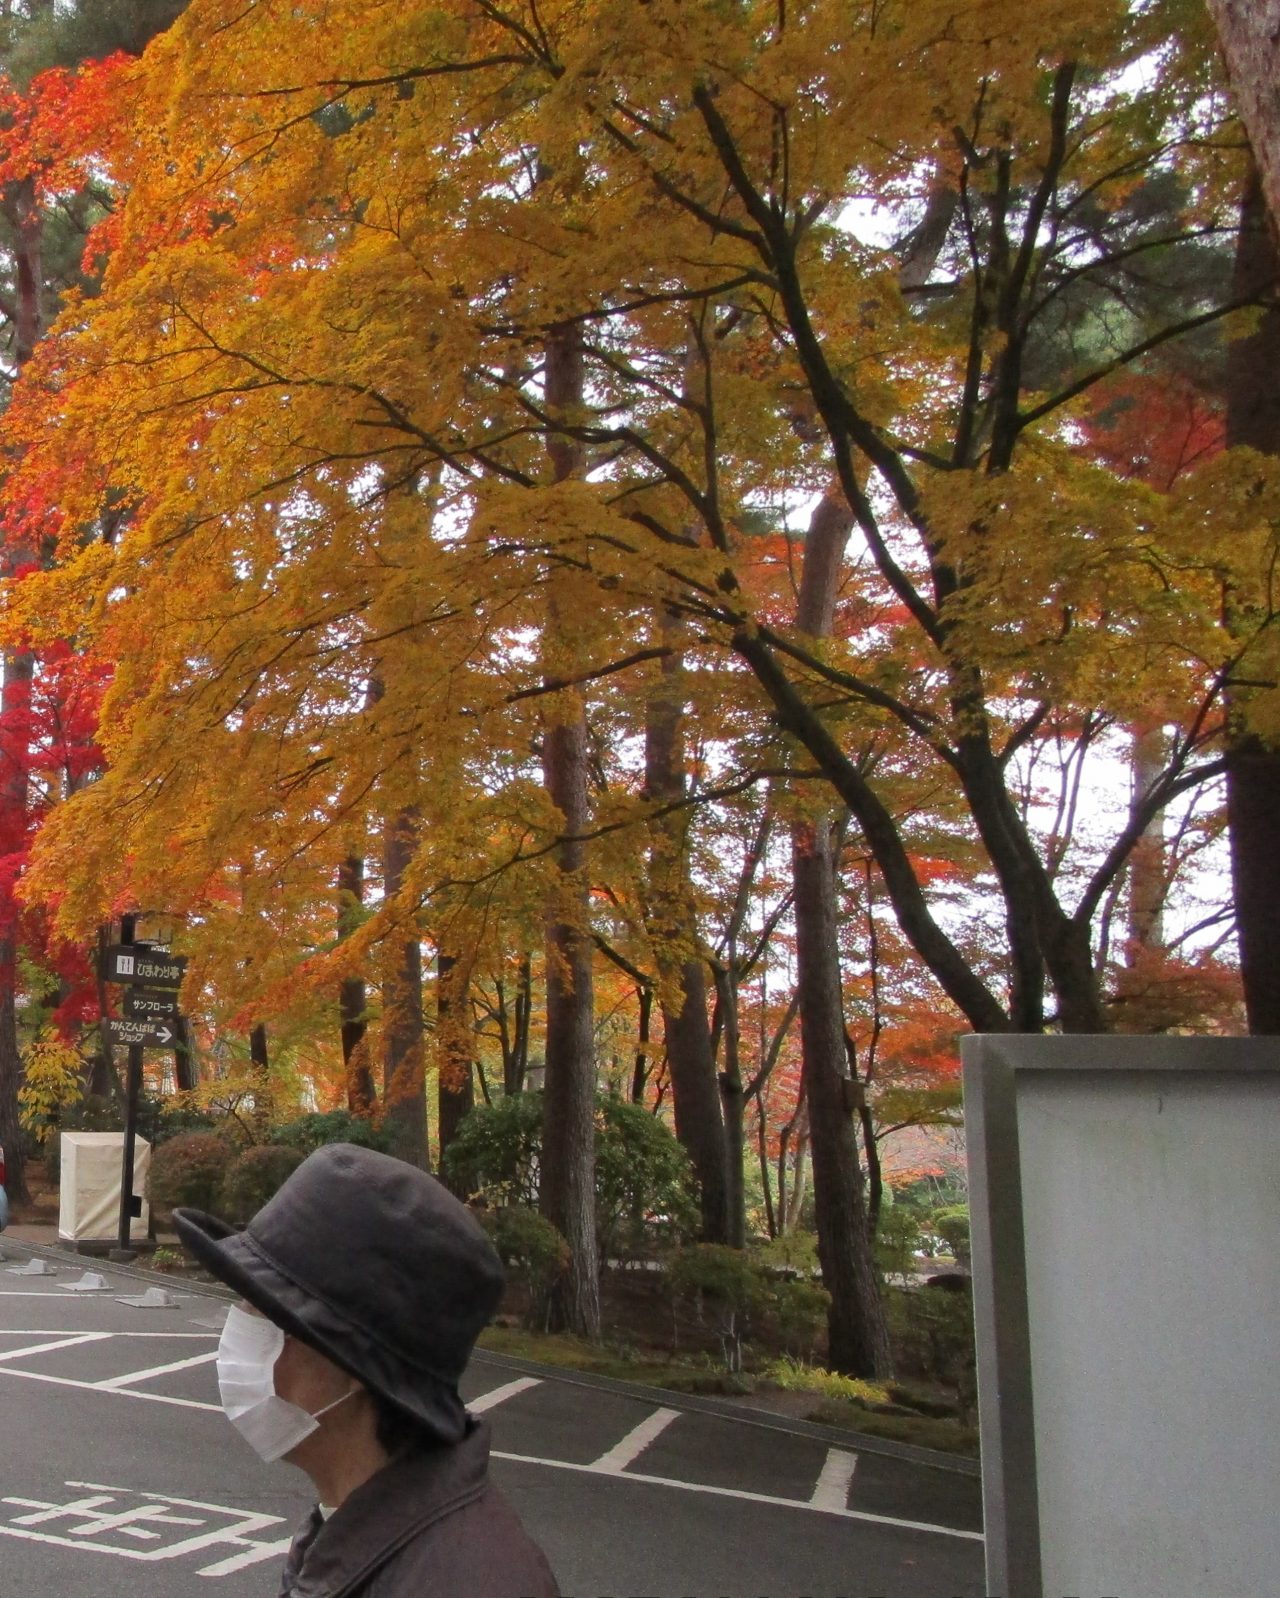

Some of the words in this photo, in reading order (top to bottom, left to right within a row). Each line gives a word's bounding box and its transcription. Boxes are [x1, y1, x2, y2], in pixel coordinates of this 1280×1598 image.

[137, 963, 180, 979] ひまわり亭
